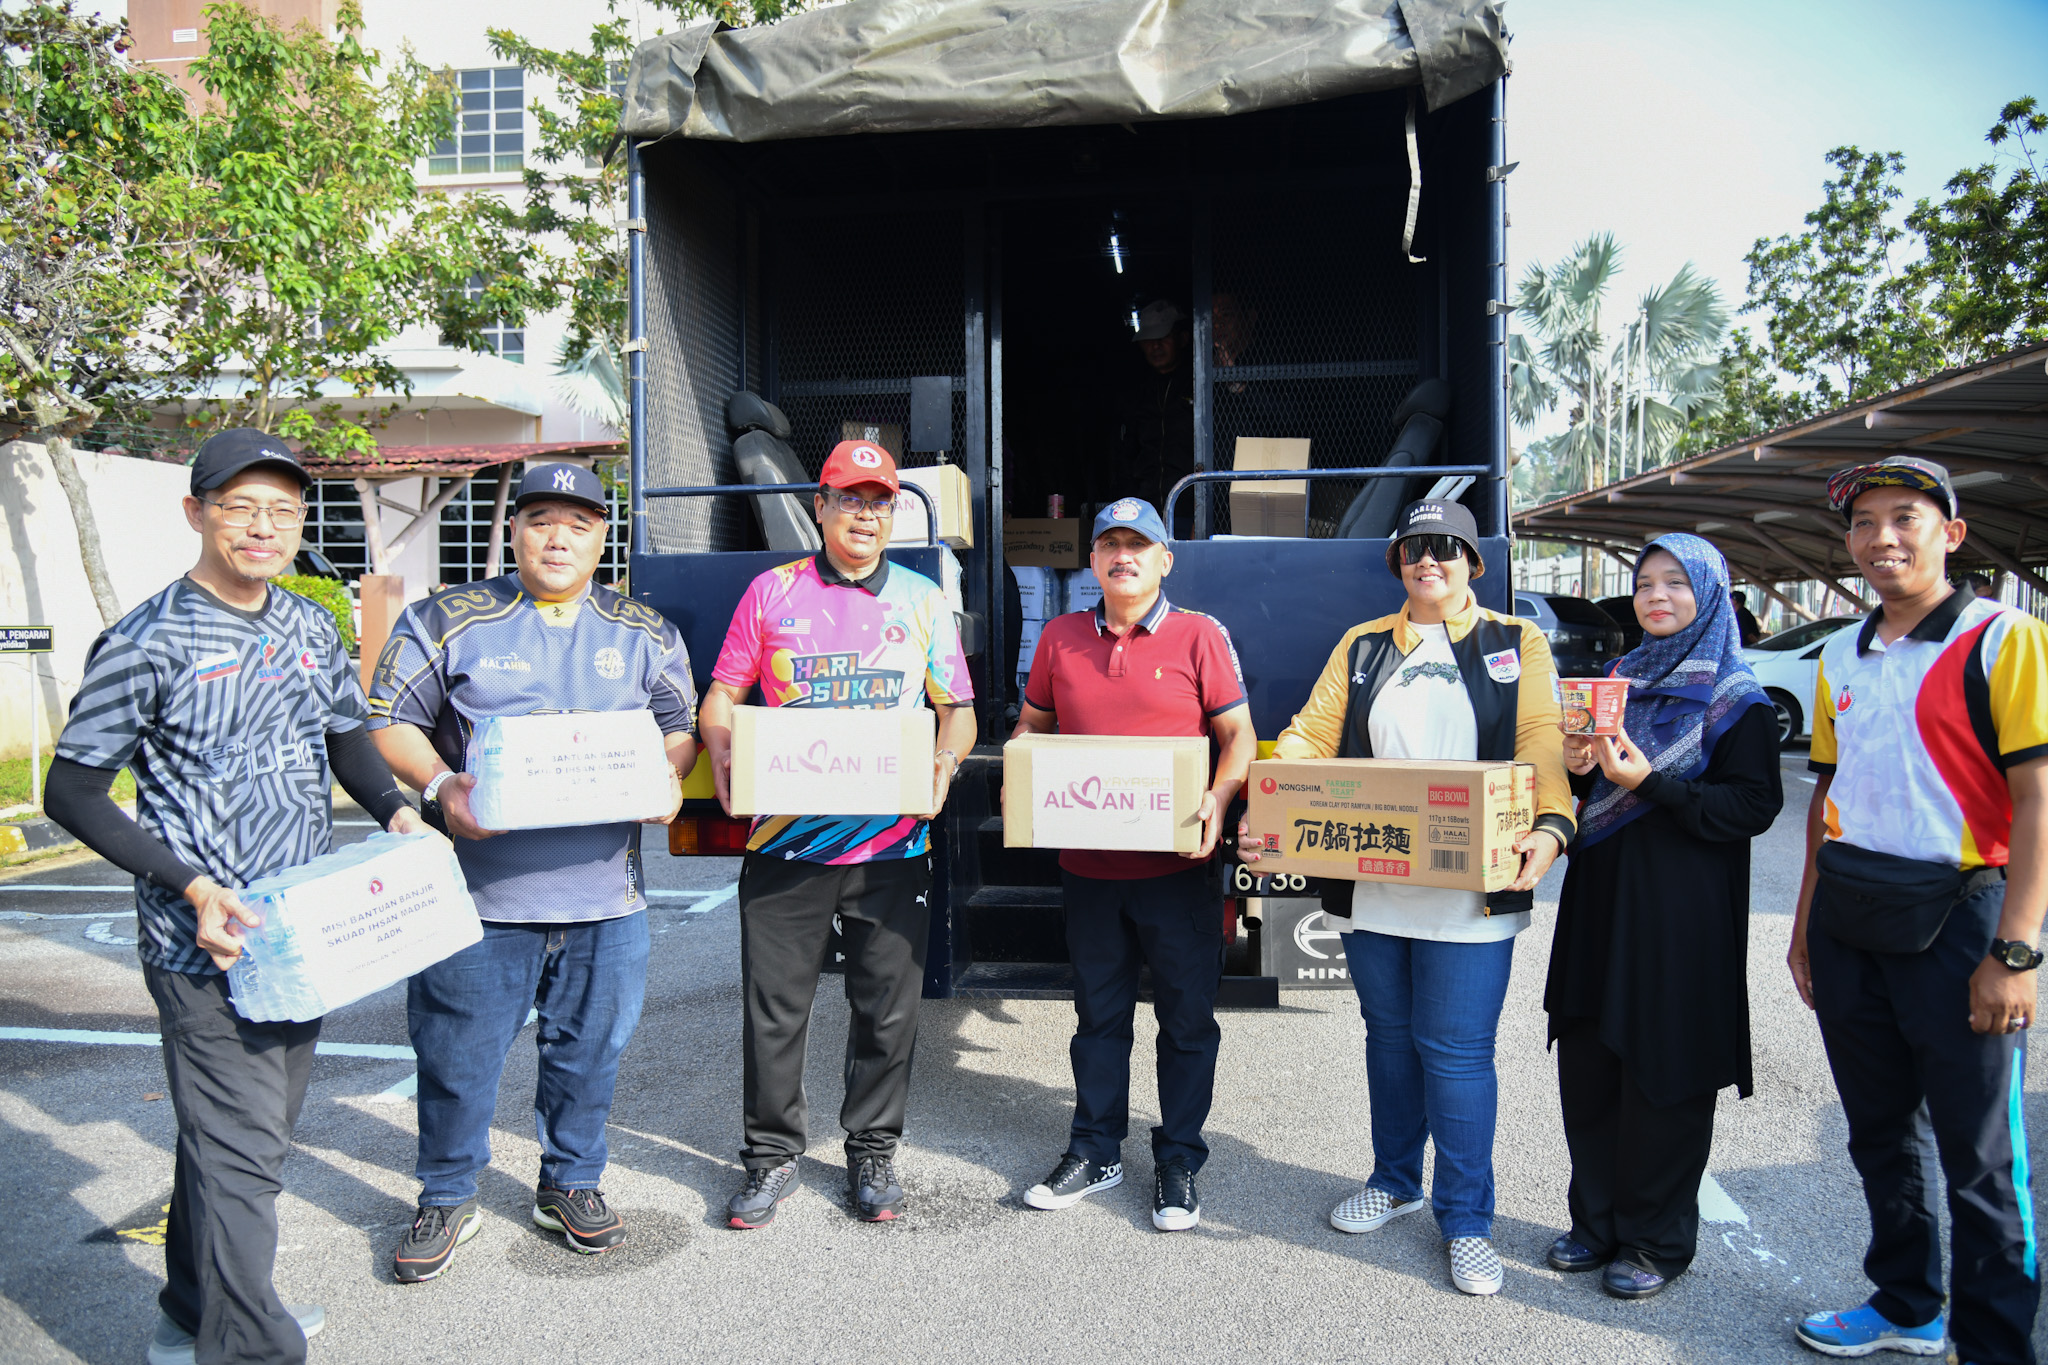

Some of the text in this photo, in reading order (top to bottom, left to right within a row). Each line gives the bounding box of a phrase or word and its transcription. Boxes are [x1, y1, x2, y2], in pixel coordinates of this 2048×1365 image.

[552, 468, 576, 491] NY
[10, 630, 49, 639] PENGARAH
[795, 656, 856, 679] HARI
[812, 678, 902, 702] SUKAN
[601, 762, 636, 770] ADANI
[1279, 783, 1320, 792] NONGSHIM
[1326, 779, 1362, 788] FARMER'S
[1330, 788, 1356, 796] HEART
[1430, 791, 1468, 803] BIG BOWL
[1429, 815, 1441, 823] 117g
[1447, 816, 1469, 824] 16Bowls
[1294, 819, 1411, 855] 石鍋拉麵
[1362, 860, 1406, 875] 濃濃香香
[322, 884, 434, 934] MISI BANTUAN BANJIR
[328, 897, 438, 948] SKUAD IHSAN MADANI
[377, 927, 403, 943] AADK
[1298, 968, 1351, 979] HIN
